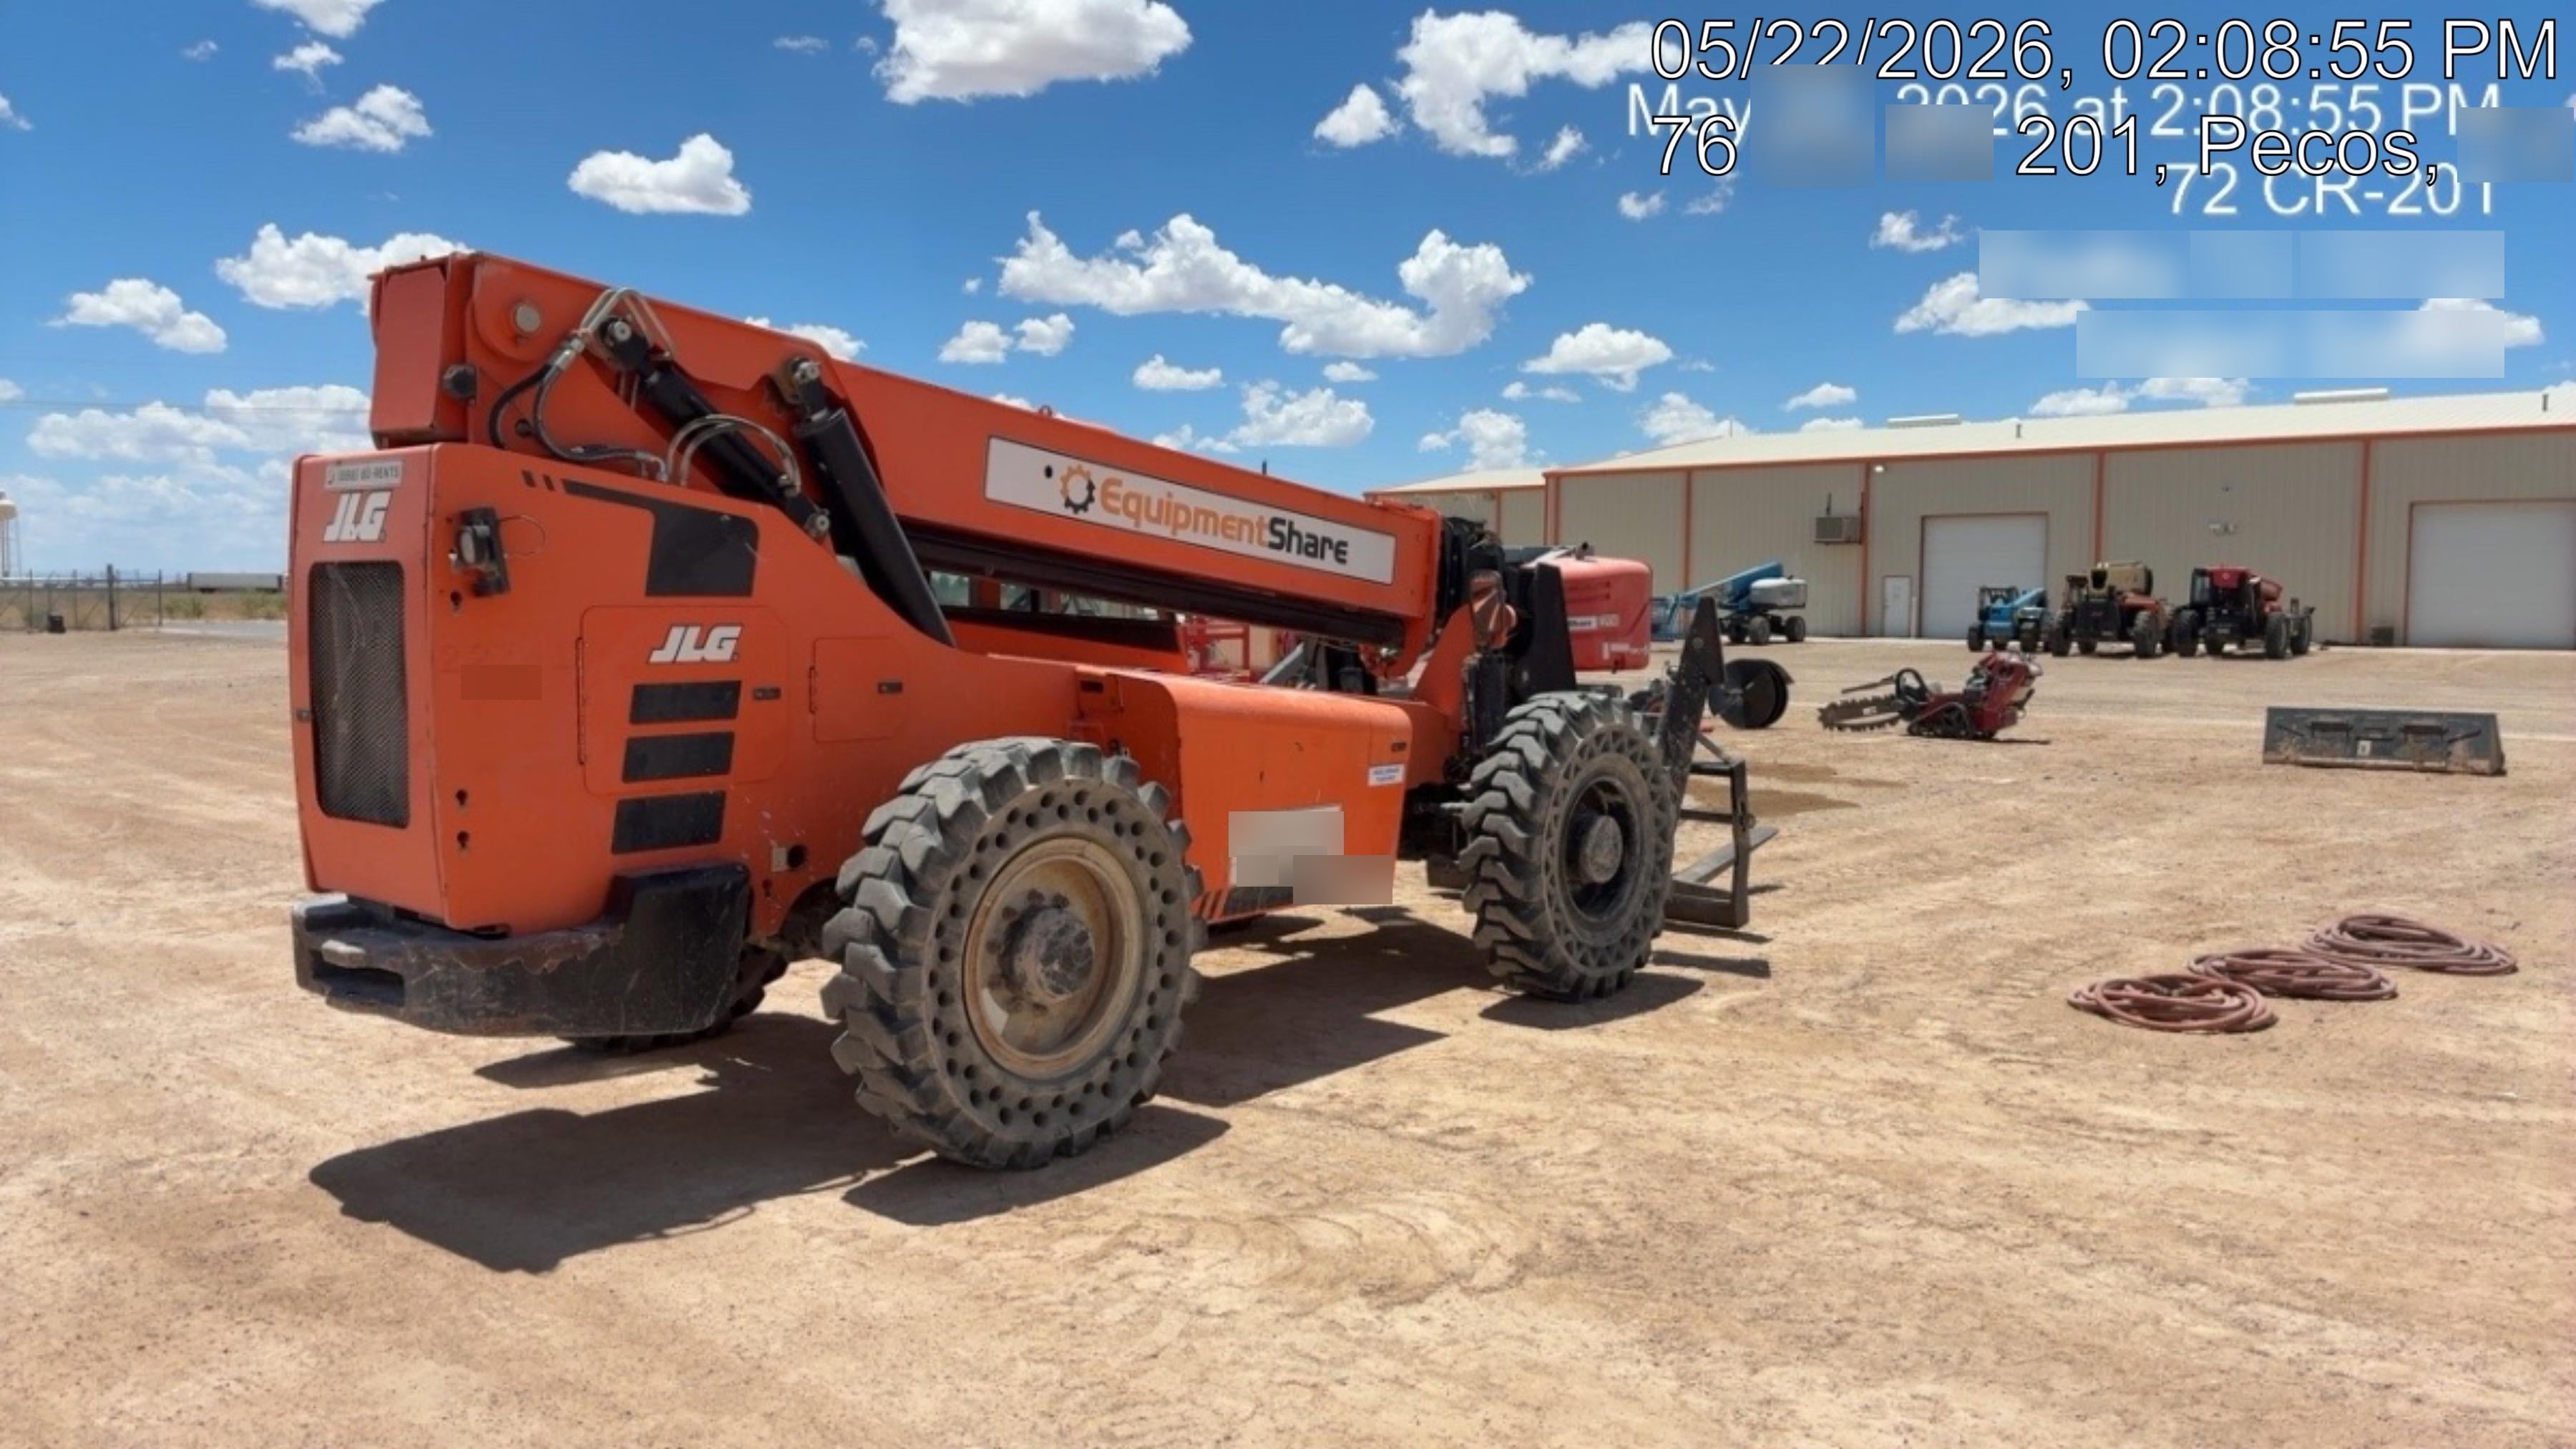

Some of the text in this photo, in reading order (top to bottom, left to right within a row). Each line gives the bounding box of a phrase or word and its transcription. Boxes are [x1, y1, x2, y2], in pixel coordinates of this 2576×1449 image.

[323, 490, 391, 542] JLG
[1101, 477, 1349, 565] EquipmentShare
[649, 625, 742, 663] JLG
